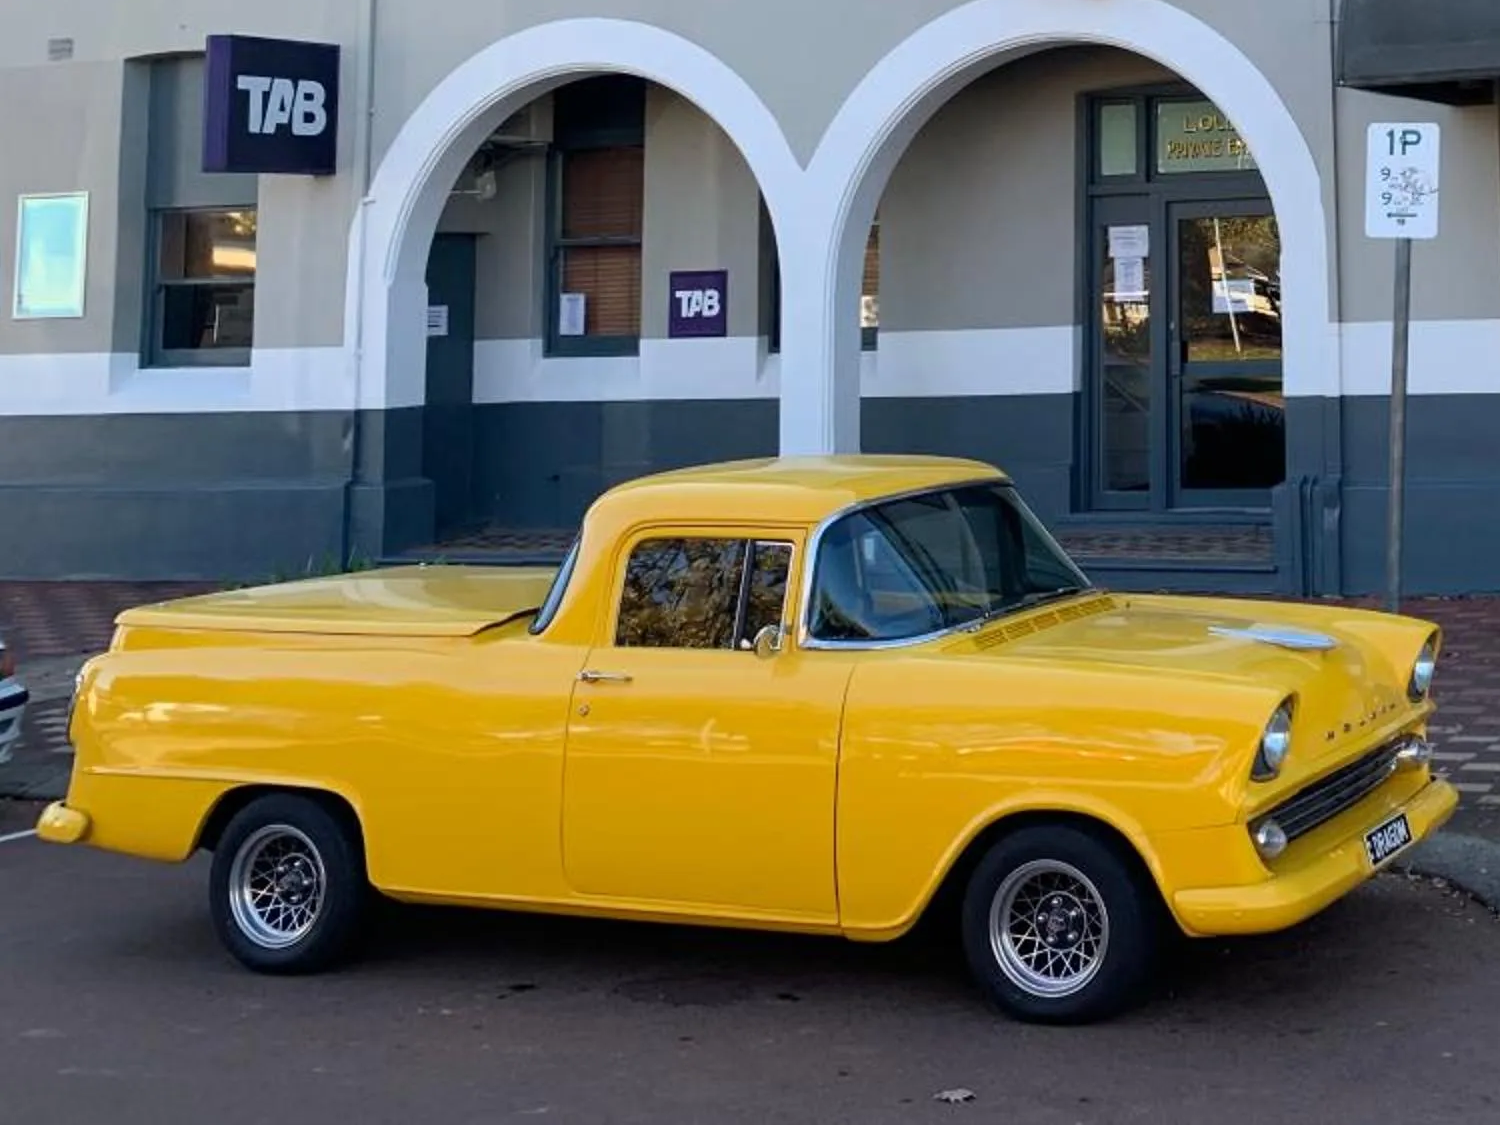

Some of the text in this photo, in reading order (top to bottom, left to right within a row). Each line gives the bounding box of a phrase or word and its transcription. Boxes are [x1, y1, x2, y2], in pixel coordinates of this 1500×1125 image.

[237, 74, 327, 136] TAB
[1386, 129, 1422, 155] 1P
[675, 288, 720, 318] TAB
